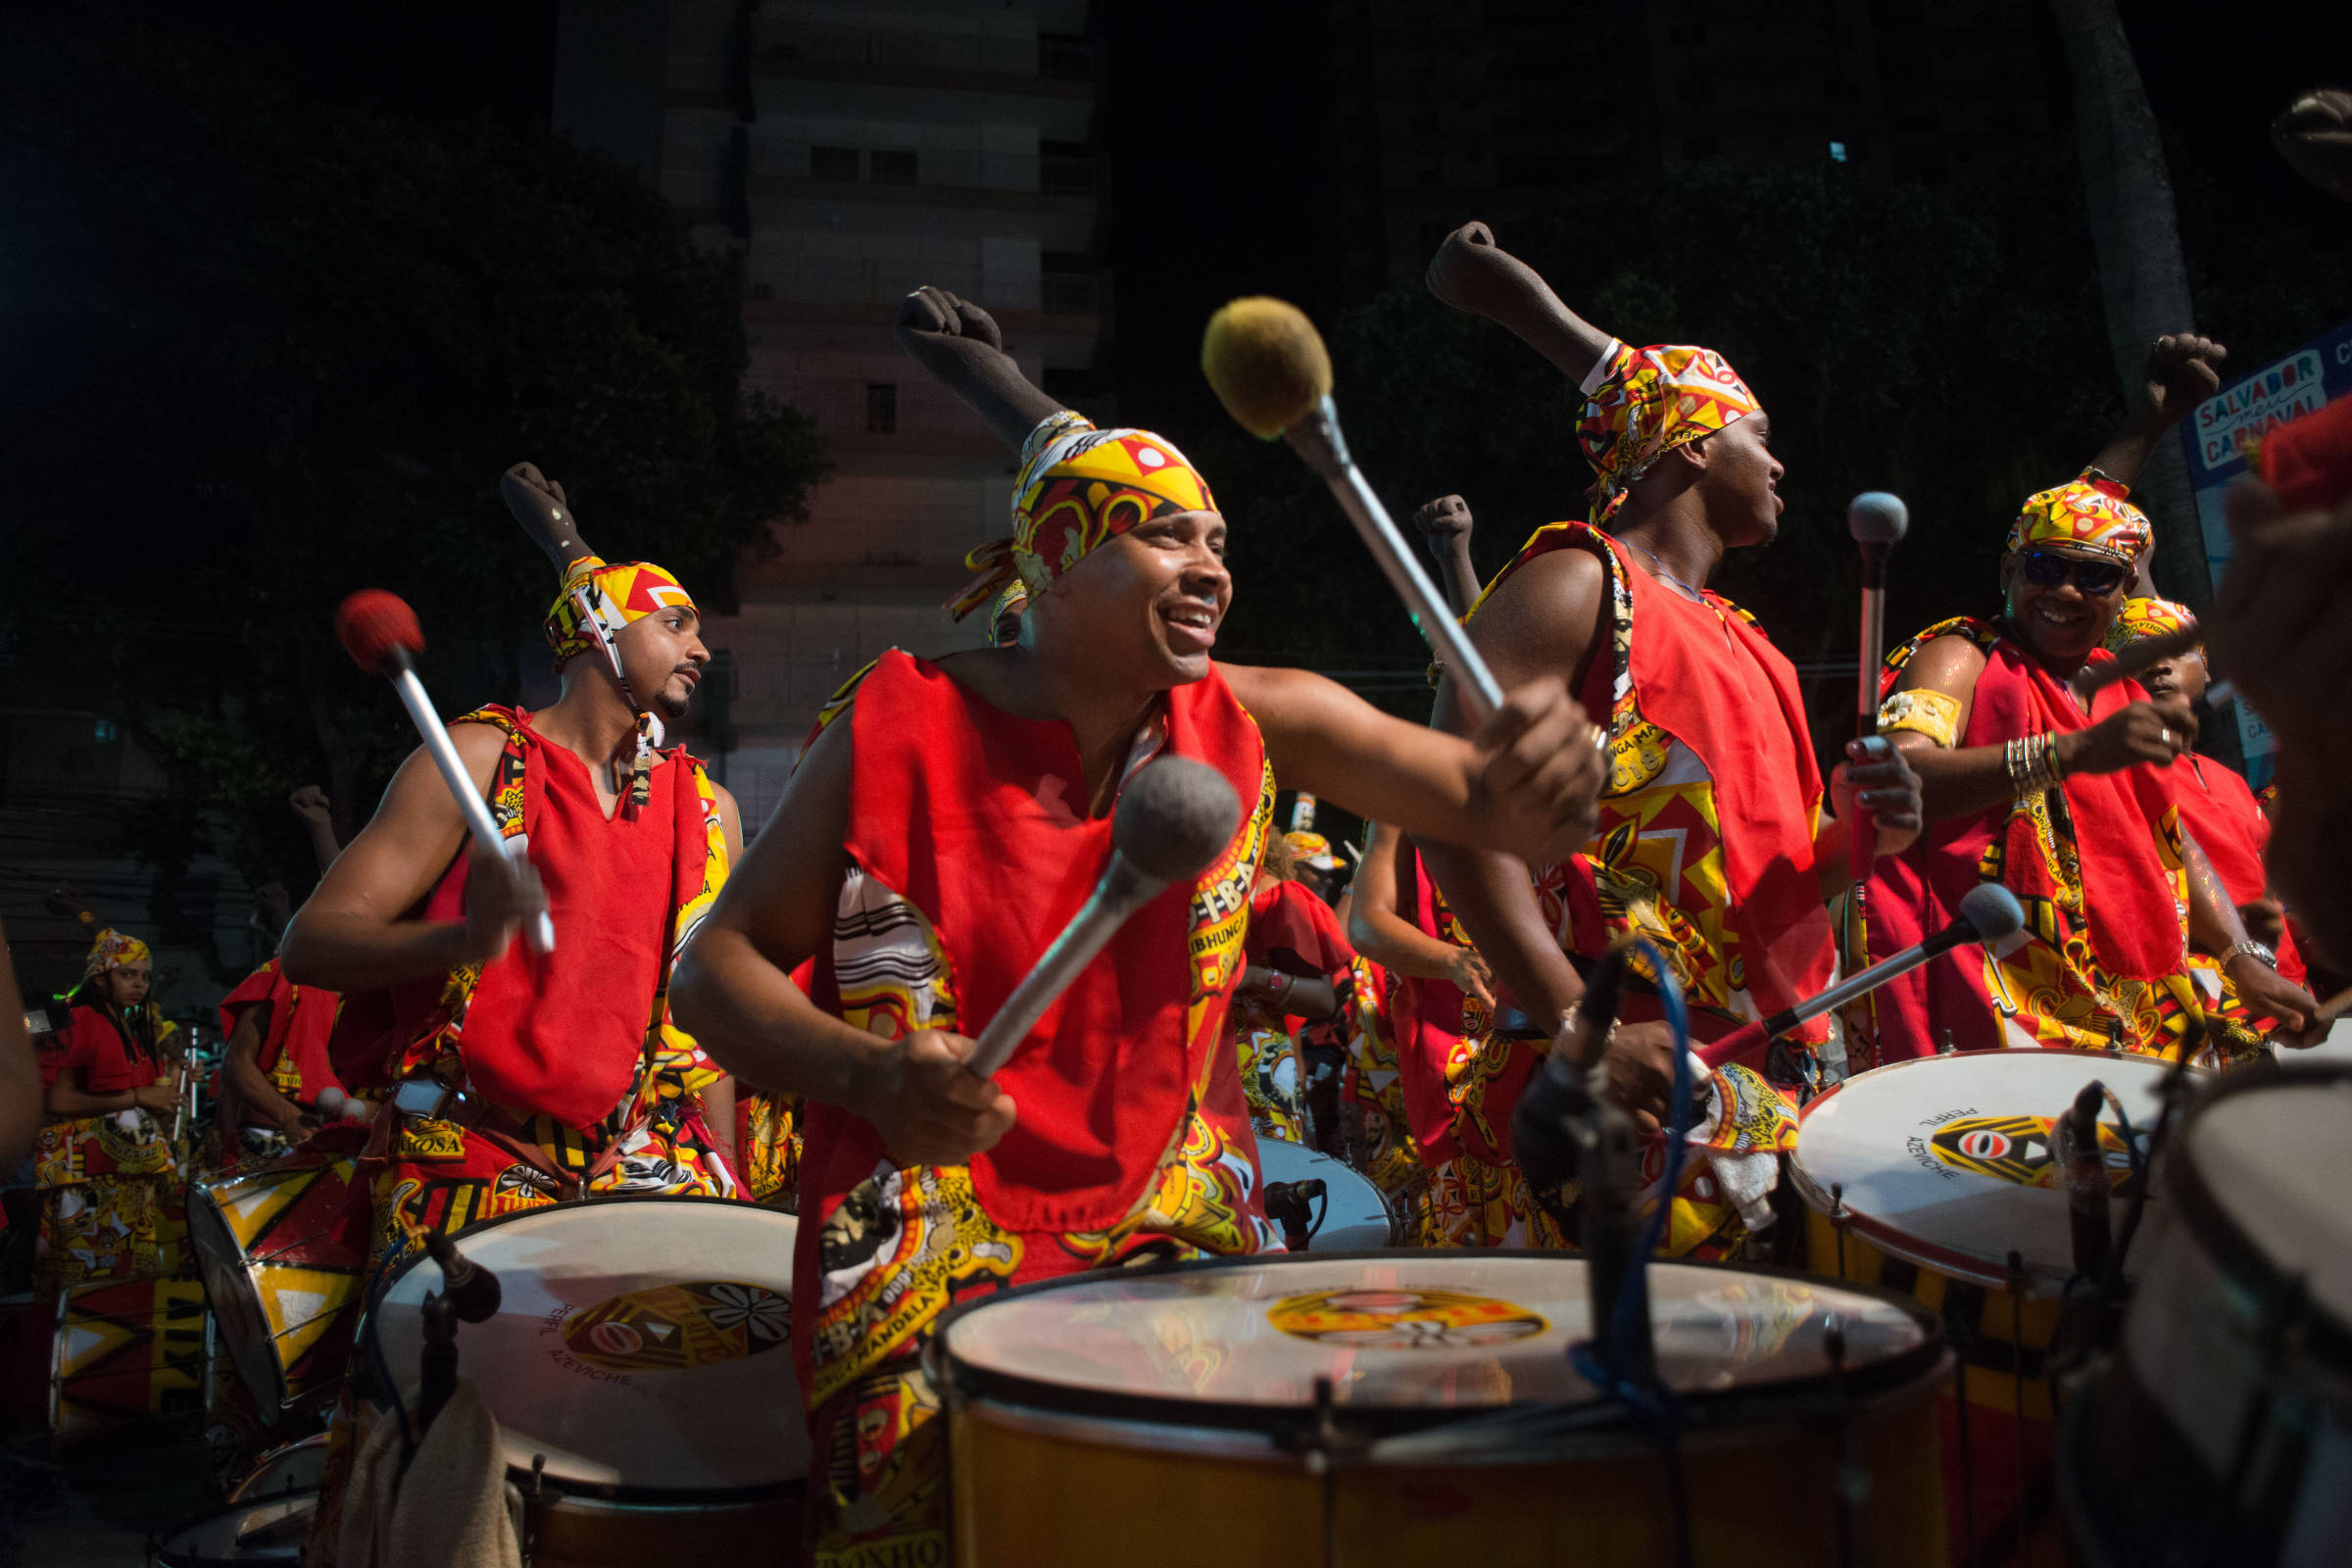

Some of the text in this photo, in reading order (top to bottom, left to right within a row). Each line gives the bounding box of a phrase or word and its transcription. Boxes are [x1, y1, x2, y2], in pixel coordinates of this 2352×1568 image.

[2200, 356, 2315, 428] SALVADOR
[1919, 1106, 1979, 1127] PERFIL
[1906, 1135, 1961, 1180] AZEVICHE
[540, 1301, 574, 1337] PERFIL
[858, 1290, 937, 1362] MANDELA
[548, 1348, 635, 1386] AZEVICHE
